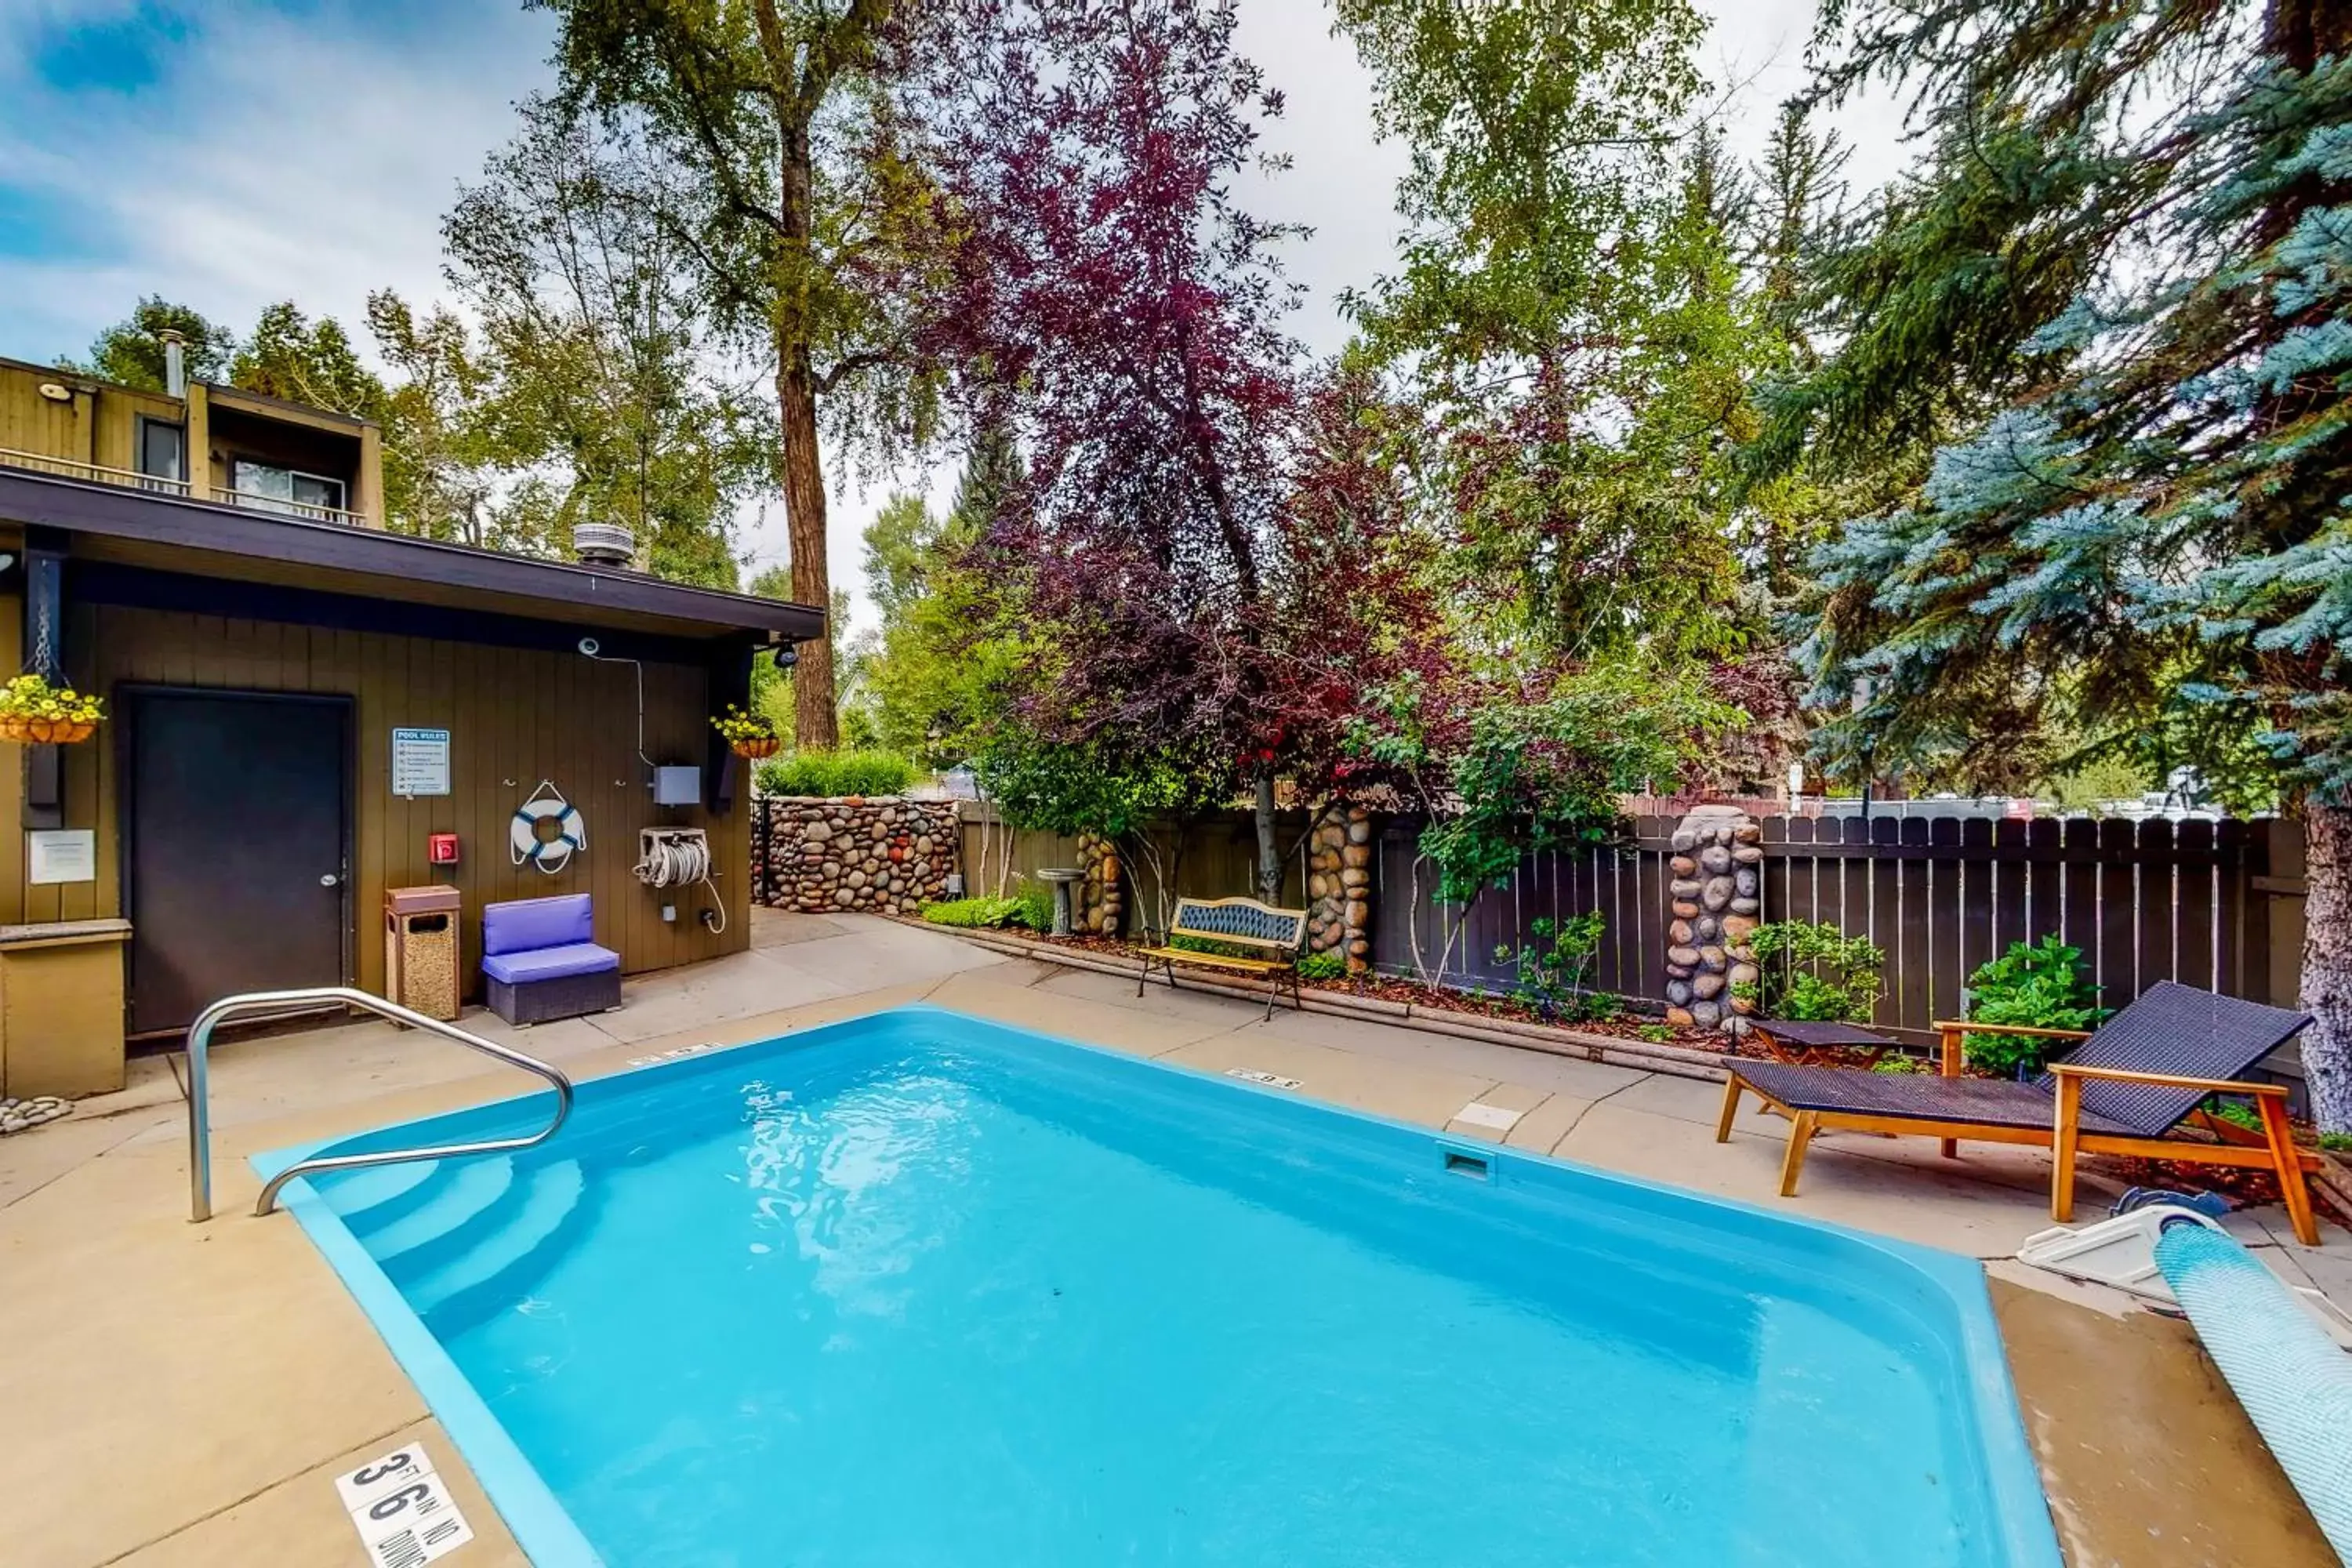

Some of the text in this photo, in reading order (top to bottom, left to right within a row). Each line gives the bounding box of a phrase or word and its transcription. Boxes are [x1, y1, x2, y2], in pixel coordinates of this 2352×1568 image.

[353, 1453, 420, 1486] 3 FT
[369, 1483, 441, 1520] 6 IN
[421, 1518, 460, 1546] NO
